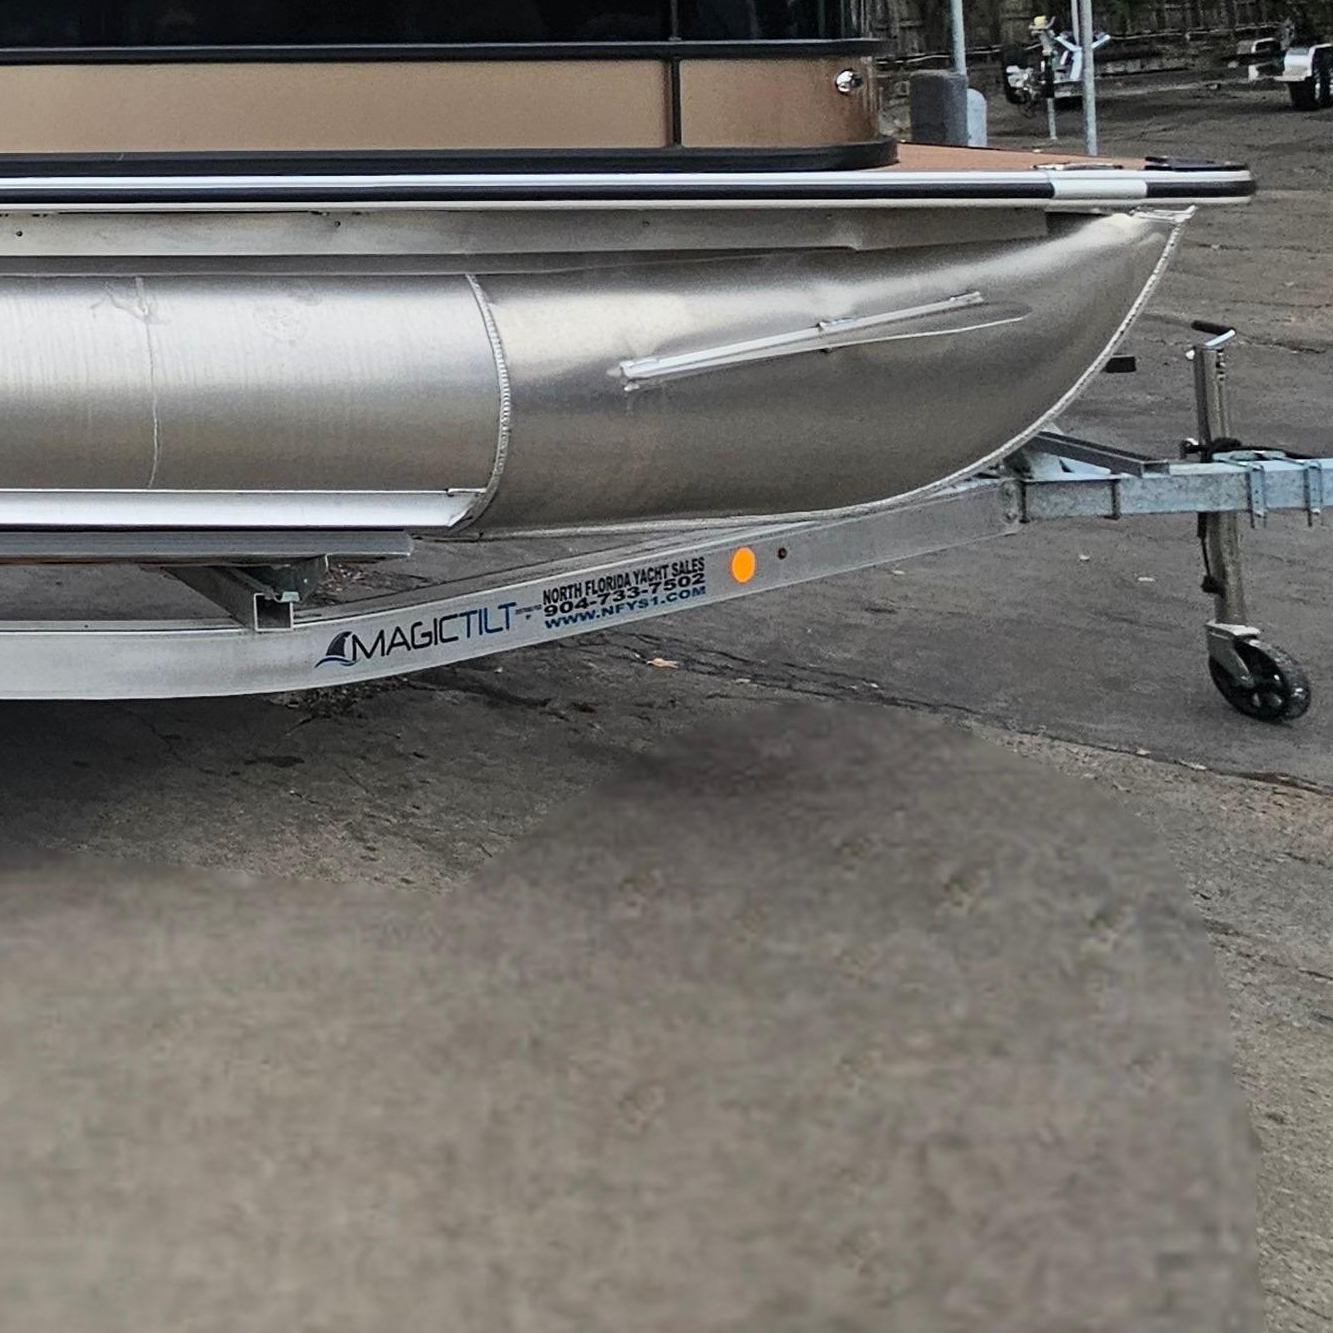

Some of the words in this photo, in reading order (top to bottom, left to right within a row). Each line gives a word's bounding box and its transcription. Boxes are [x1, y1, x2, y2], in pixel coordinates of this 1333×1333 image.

[542, 582, 582, 605] NORTH
[585, 571, 632, 596] FLORIDA
[633, 565, 670, 585] YACHT
[671, 556, 705, 577] SALES
[543, 572, 705, 617] 904-733-7502
[544, 585, 707, 629] WWW.NFYS1.COM
[351, 601, 517, 662] MAGICTILT
